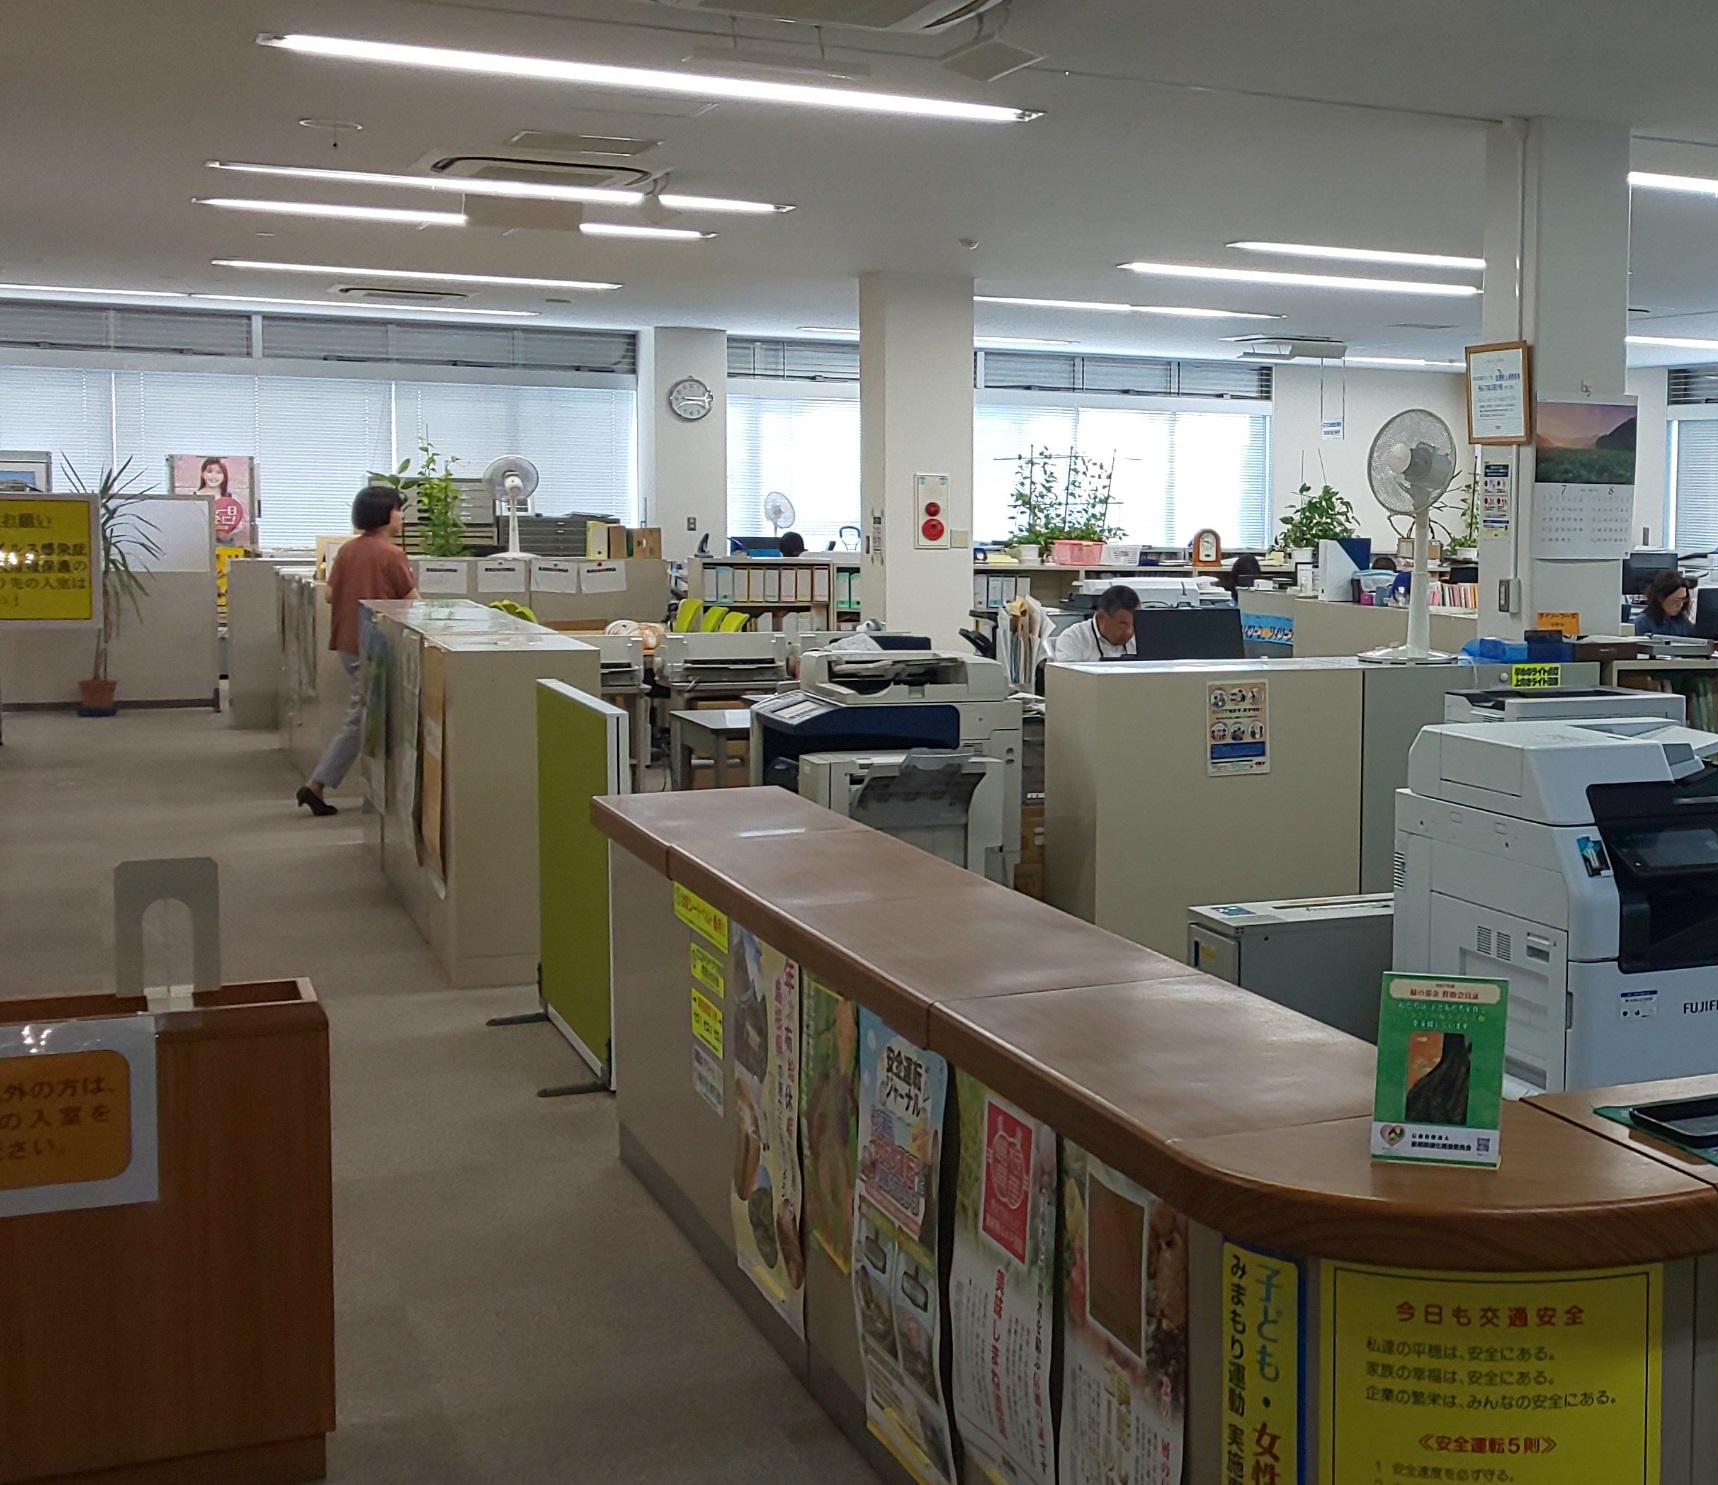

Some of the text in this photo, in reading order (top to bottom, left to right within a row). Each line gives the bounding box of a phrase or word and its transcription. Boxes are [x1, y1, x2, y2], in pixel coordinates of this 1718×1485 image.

[1561, 485, 1567, 495] 7
[1395, 1300, 1586, 1328] 今日も交通安全
[1227, 1253, 1247, 1418] みまもり運動
[1365, 1336, 1556, 1362] 私達の平穏は、安全にある。
[1365, 1360, 1555, 1387] 家族の幸福は、安全にある。
[1365, 1385, 1617, 1411] 企業の繁栄は、みんなの安全にある。
[1392, 1461, 1515, 1483] 安全速度を必ず守る。
